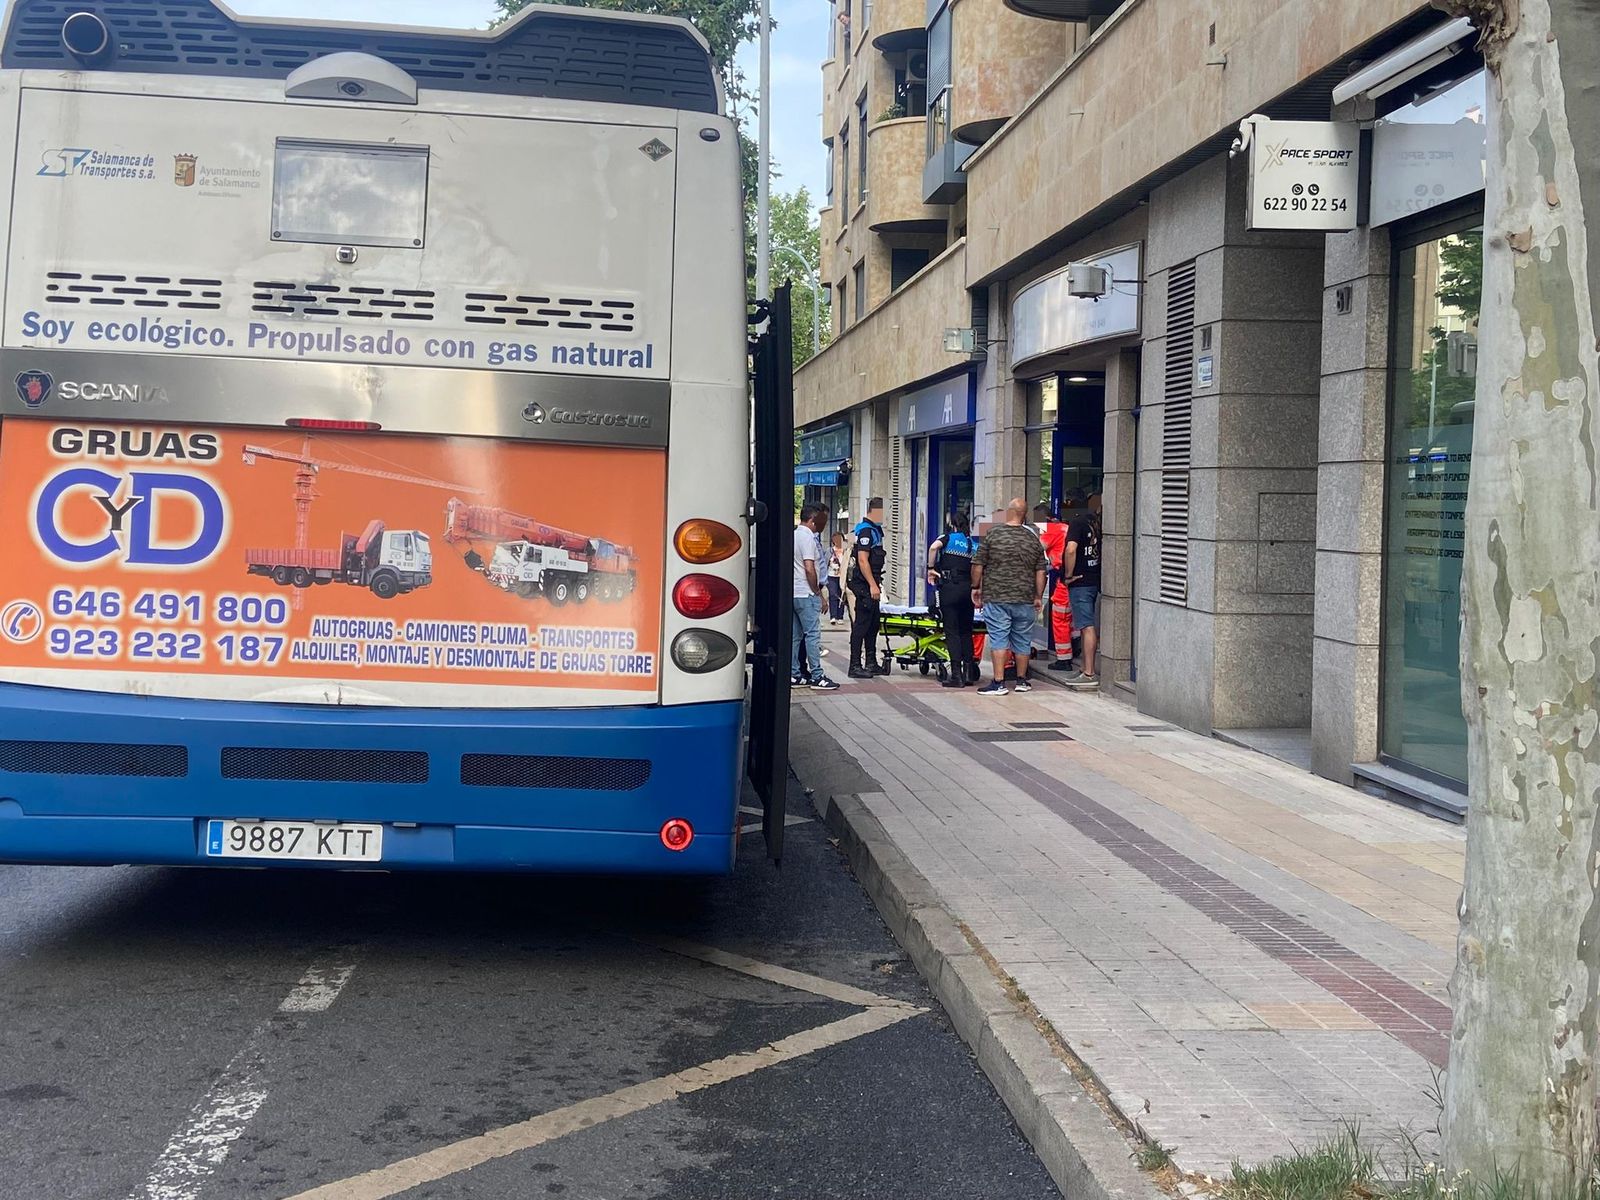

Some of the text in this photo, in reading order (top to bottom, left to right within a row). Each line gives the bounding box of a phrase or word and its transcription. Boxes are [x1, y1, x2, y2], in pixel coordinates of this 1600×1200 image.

[645, 144, 665, 154] GNC
[1312, 149, 1353, 159] SPORT
[91, 150, 154, 167] Salamanca de
[80, 162, 156, 179] Transportes s.a.
[200, 166, 261, 177] Ayuntamiento
[199, 177, 260, 188] de Salamanca
[1263, 198, 1347, 211] 622 90 22 54
[22, 311, 653, 369] Soy ecológico. Propulsado con gas natural
[52, 428, 218, 460] GRUAS
[52, 589, 286, 624] 646 491 800
[312, 618, 393, 640] AUTOGRUAS
[405, 622, 476, 643] CAMIONES
[481, 625, 528, 646] PLUMA
[540, 628, 635, 650] TRANSPORTES
[50, 628, 284, 662] 923 232 187
[291, 641, 652, 674] ALQUILER, MONTAJE Y DESMONTAJE DE GRUAS TORRE
[212, 841, 219, 850] E
[230, 825, 373, 856] 9887 KTT
